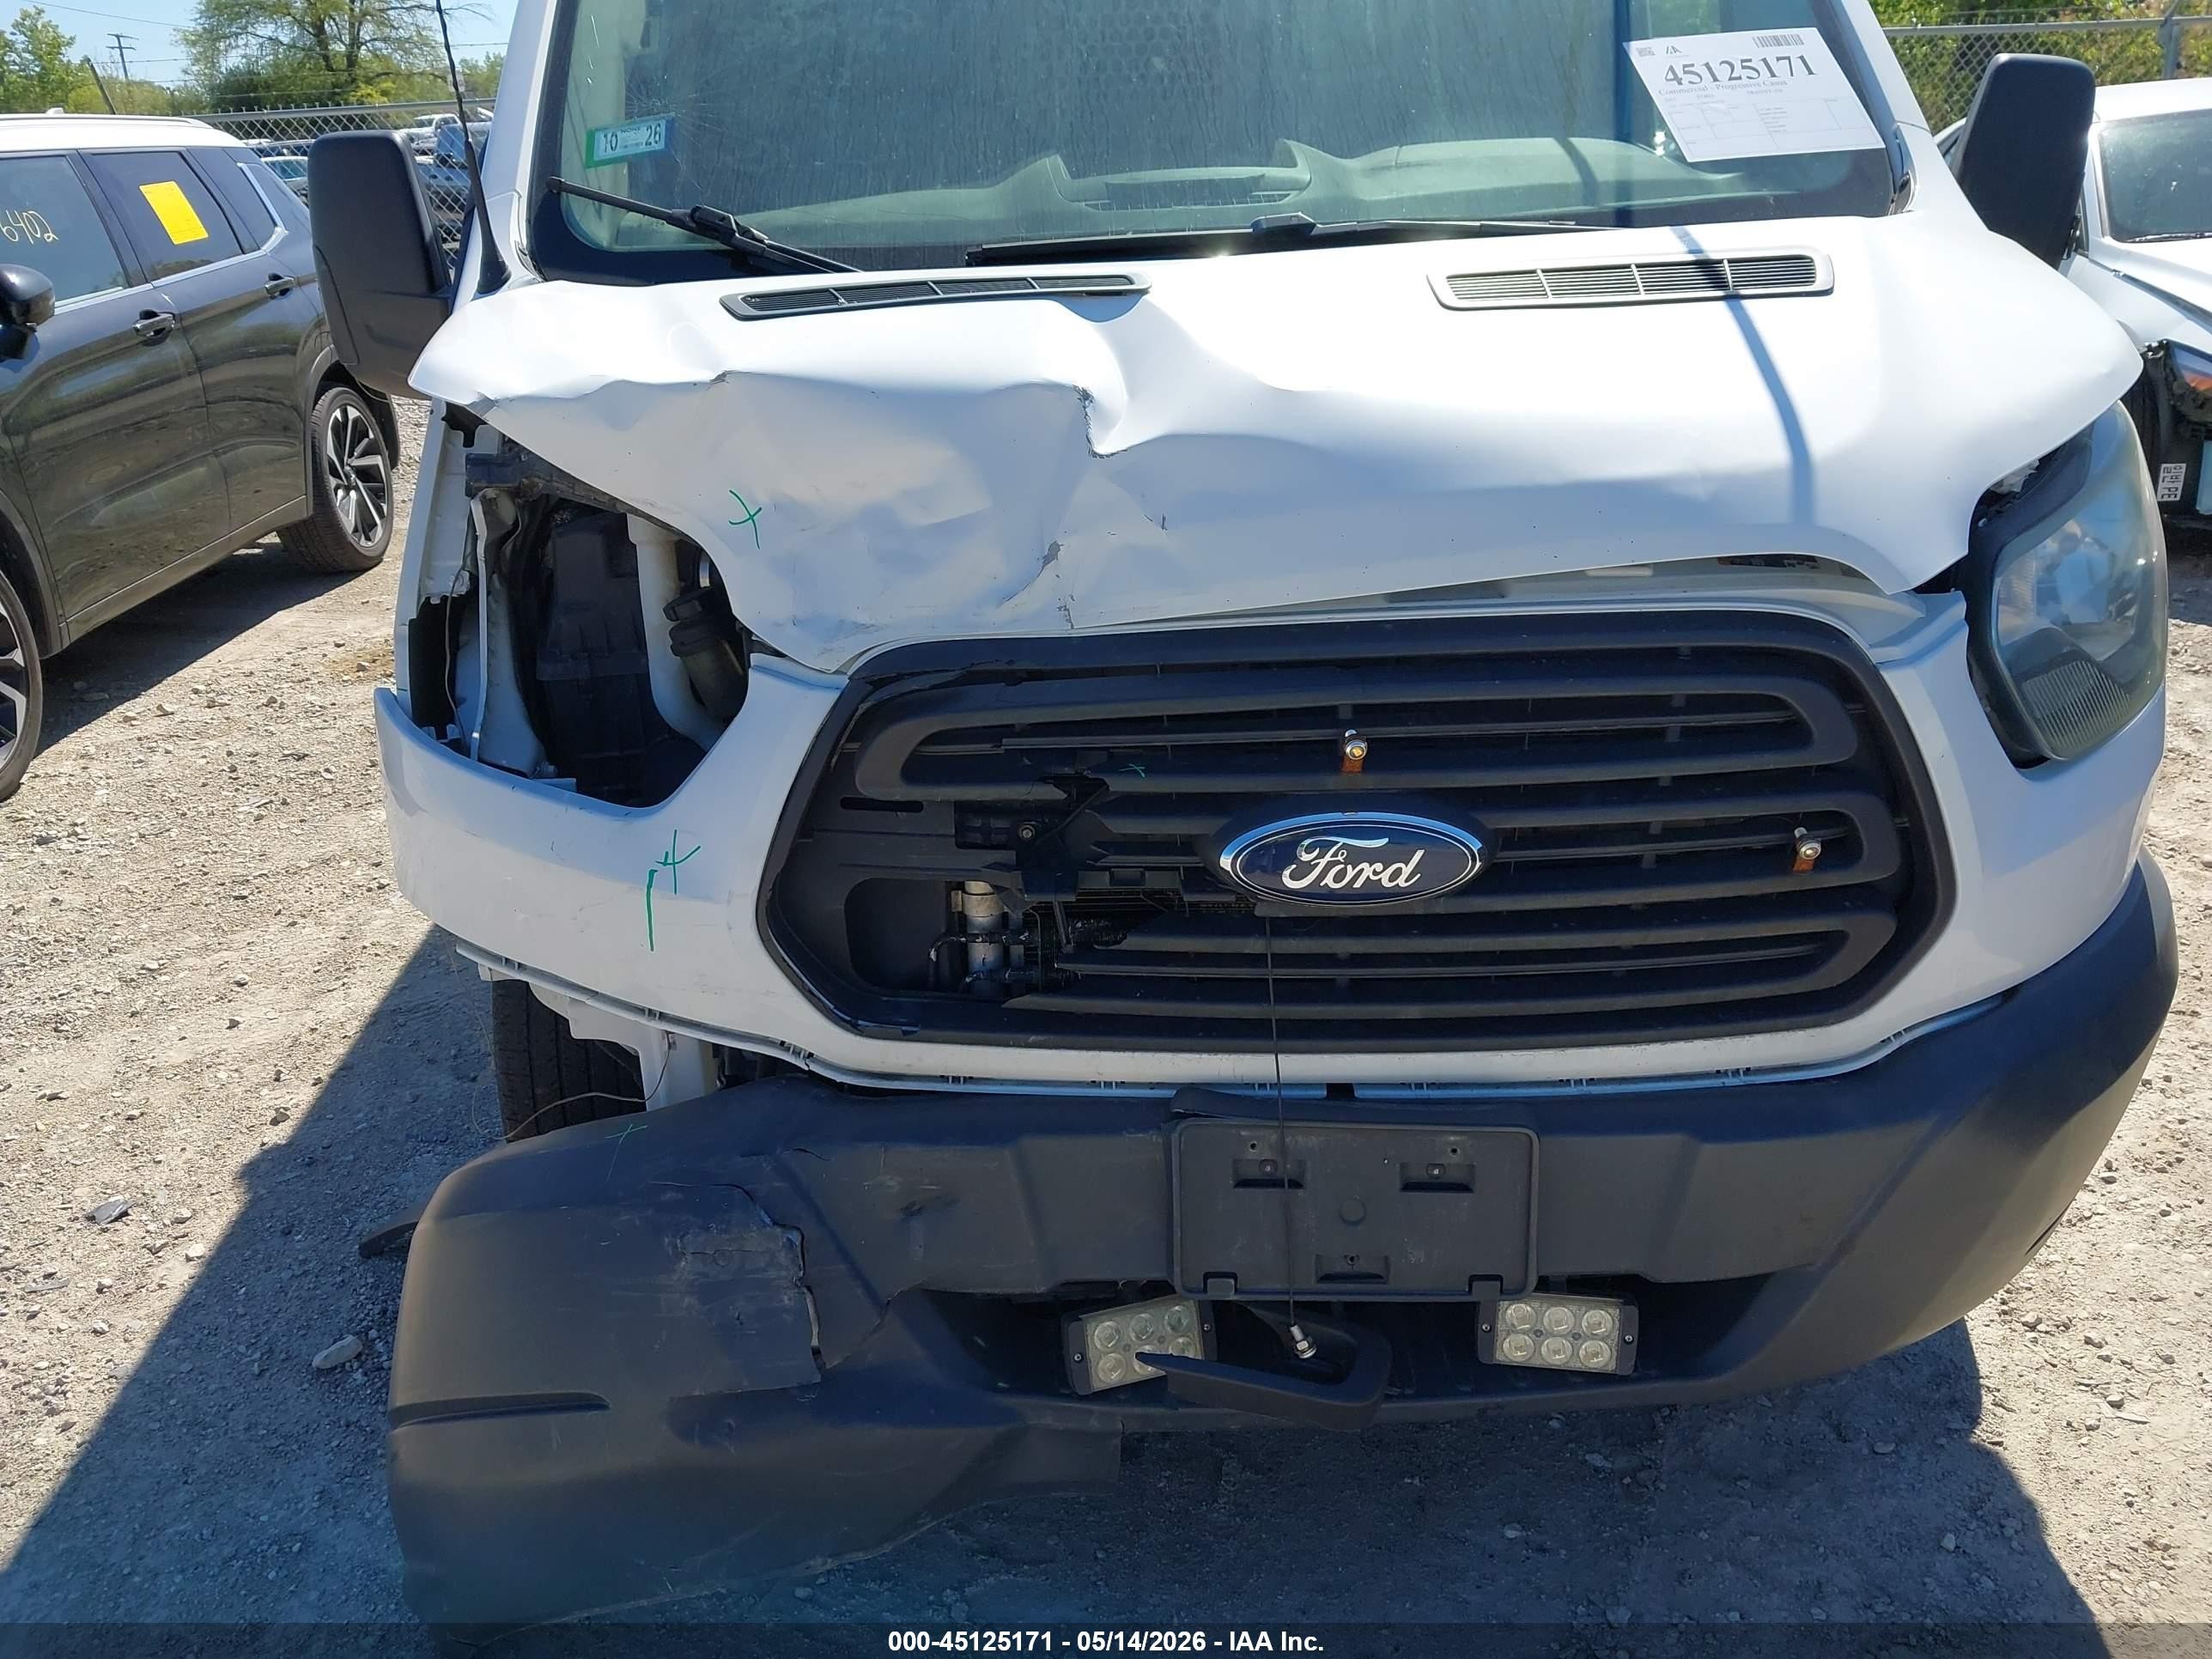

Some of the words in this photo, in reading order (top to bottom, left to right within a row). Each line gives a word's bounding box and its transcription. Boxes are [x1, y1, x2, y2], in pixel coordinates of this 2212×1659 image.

[1664, 54, 1820, 86] 45125171
[1658, 85, 1708, 95] Commercial
[1716, 82, 1762, 91] Progressive
[603, 131, 618, 153] 10
[645, 123, 661, 146] 26
[2160, 486, 2179, 500] PE
[1282, 836, 1425, 890] Ford
